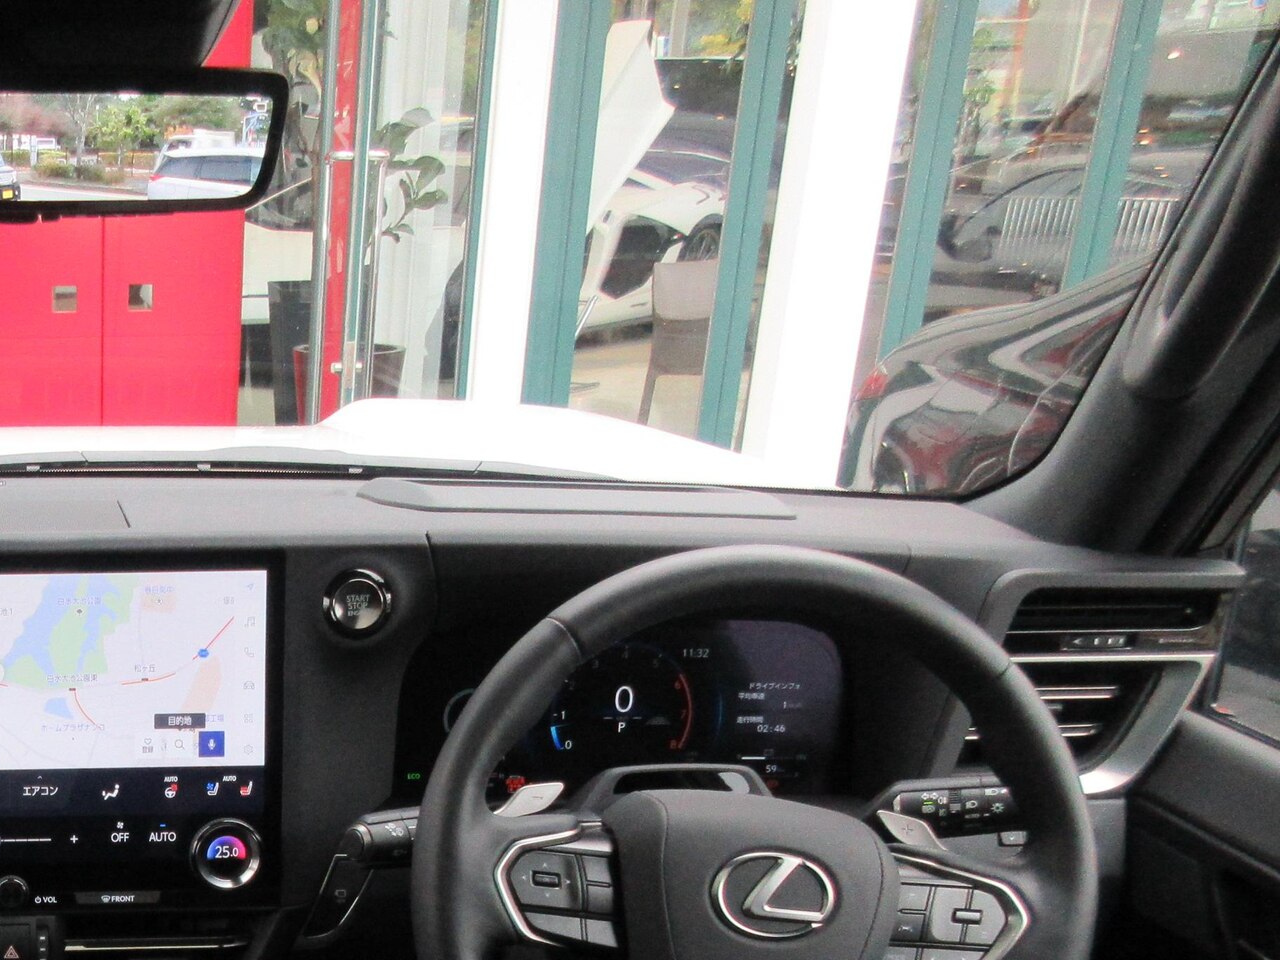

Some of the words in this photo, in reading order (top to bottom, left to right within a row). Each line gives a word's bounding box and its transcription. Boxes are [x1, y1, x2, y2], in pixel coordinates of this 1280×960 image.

[346, 594, 370, 602] START
[348, 602, 368, 610] STOP
[682, 648, 710, 658] 11:32
[614, 685, 634, 713] 0
[561, 711, 567, 720] 1
[167, 716, 192, 726] 目的地
[617, 722, 626, 733] P
[757, 725, 786, 733] 02:46
[565, 740, 573, 750] 0
[765, 764, 777, 773] 59
[22, 786, 58, 796] エアコン
[110, 832, 130, 843] OFF
[149, 832, 177, 842] AUTO
[214, 846, 239, 859] 25.0
[111, 895, 135, 903] FRONT
